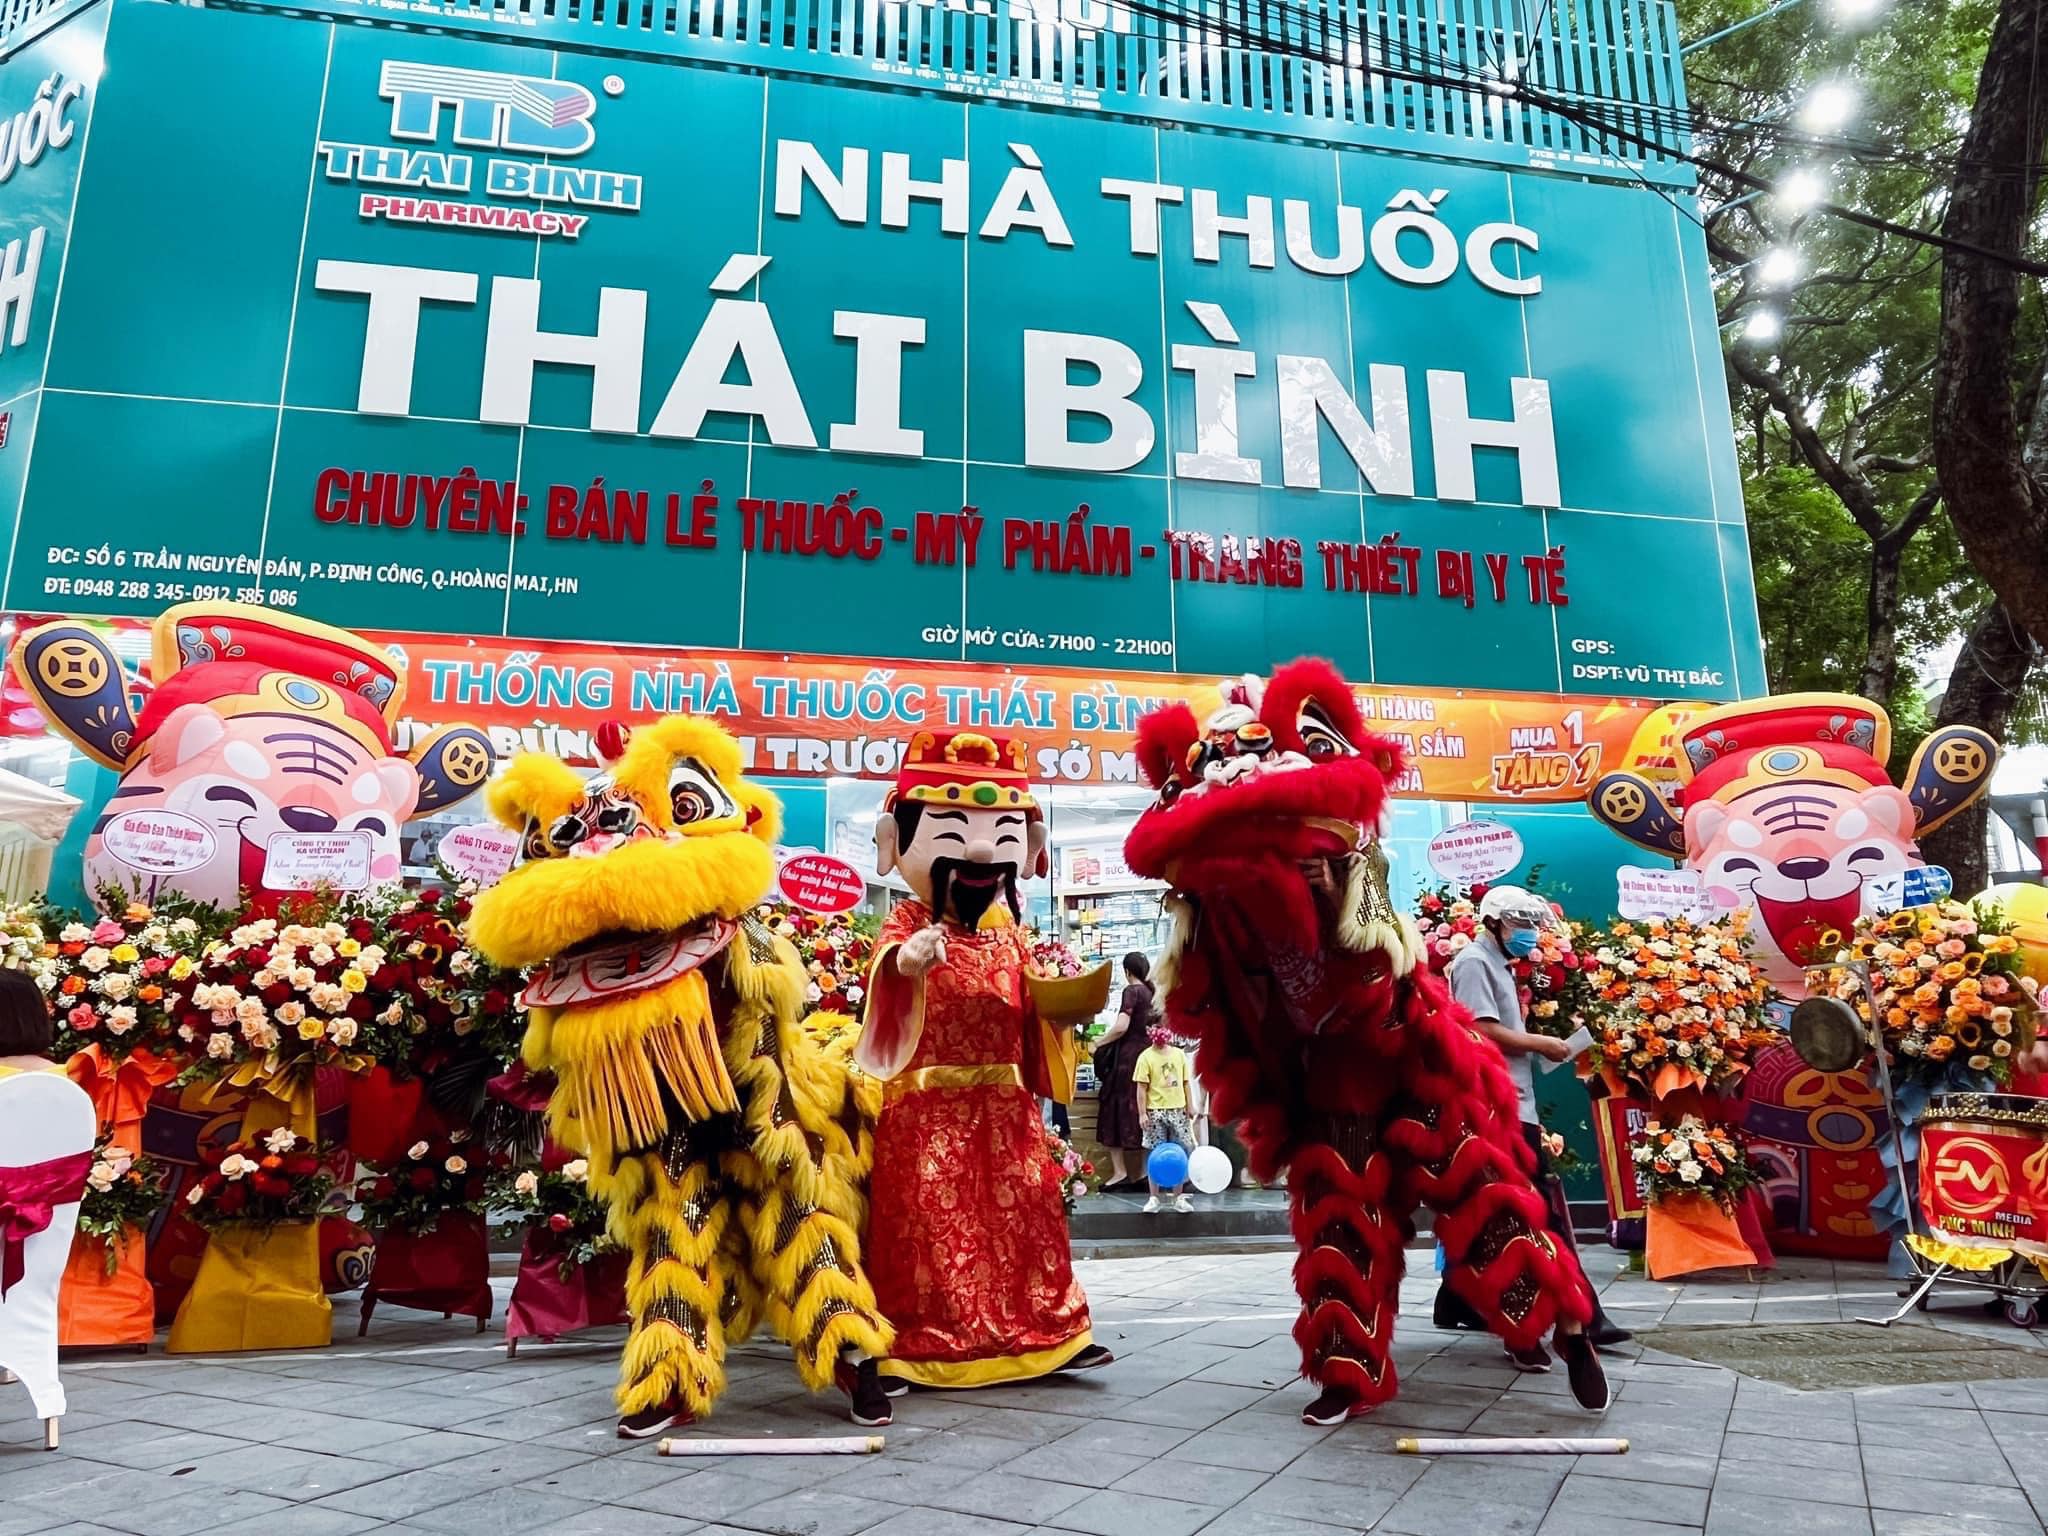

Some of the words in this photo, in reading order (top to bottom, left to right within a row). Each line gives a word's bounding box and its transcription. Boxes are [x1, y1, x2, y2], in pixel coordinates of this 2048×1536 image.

[318, 140, 473, 192] THAI
[486, 158, 643, 211] BINH
[359, 193, 589, 239] PHARMACY
[774, 138, 1075, 247] NHÀ
[1100, 177, 1543, 297] THUỐC
[315, 253, 926, 458] THÁI
[1023, 299, 1562, 509] BÌNH
[315, 466, 528, 536] CHUYÊN:
[545, 476, 649, 546] BÁN
[664, 479, 719, 549] LẺ
[1162, 528, 1304, 590] TRANG
[1316, 531, 1422, 598] THIẾT
[1437, 548, 1475, 609] BỊ
[1483, 553, 1508, 602] Y
[1523, 544, 1570, 607] TẾ
[47, 547, 80, 565] ĐC:
[84, 543, 111, 567] SỐ
[114, 550, 126, 567] 6
[133, 545, 181, 570] TRẦN
[187, 554, 260, 575] NGUYÊN
[73, 578, 114, 597] 0948
[118, 580, 150, 600] 288
[269, 588, 298, 608] 086
[921, 624, 959, 644] GIỜ
[965, 626, 998, 646] MỞ
[1001, 628, 1045, 649] CỬA:
[1048, 634, 1096, 652] 7H00
[1114, 638, 1173, 657] 22H00
[1571, 638, 1616, 655] GPS:
[422, 650, 614, 710] THỐNG
[630, 661, 741, 717] NHÀ
[752, 668, 926, 724] THUỐC
[937, 675, 1057, 730] THÁI
[1071, 682, 1180, 733] BÌN
[1572, 664, 1623, 681] DSPT:
[1624, 664, 1650, 683] VŨ
[1653, 668, 1686, 689] THỊ
[1688, 665, 1725, 686] BẮC
[1380, 694, 1436, 722] HÀNG
[1420, 727, 1466, 759] SẮM
[1510, 726, 1558, 751] MUA
[1561, 710, 1585, 747] 1
[766, 735, 908, 775] TRƯƠ
[1035, 739, 1092, 782] SỞ
[1492, 752, 1572, 796] TẶNG
[1971, 1218, 2016, 1239] MINH
[1994, 1211, 2033, 1225] MEDIA
